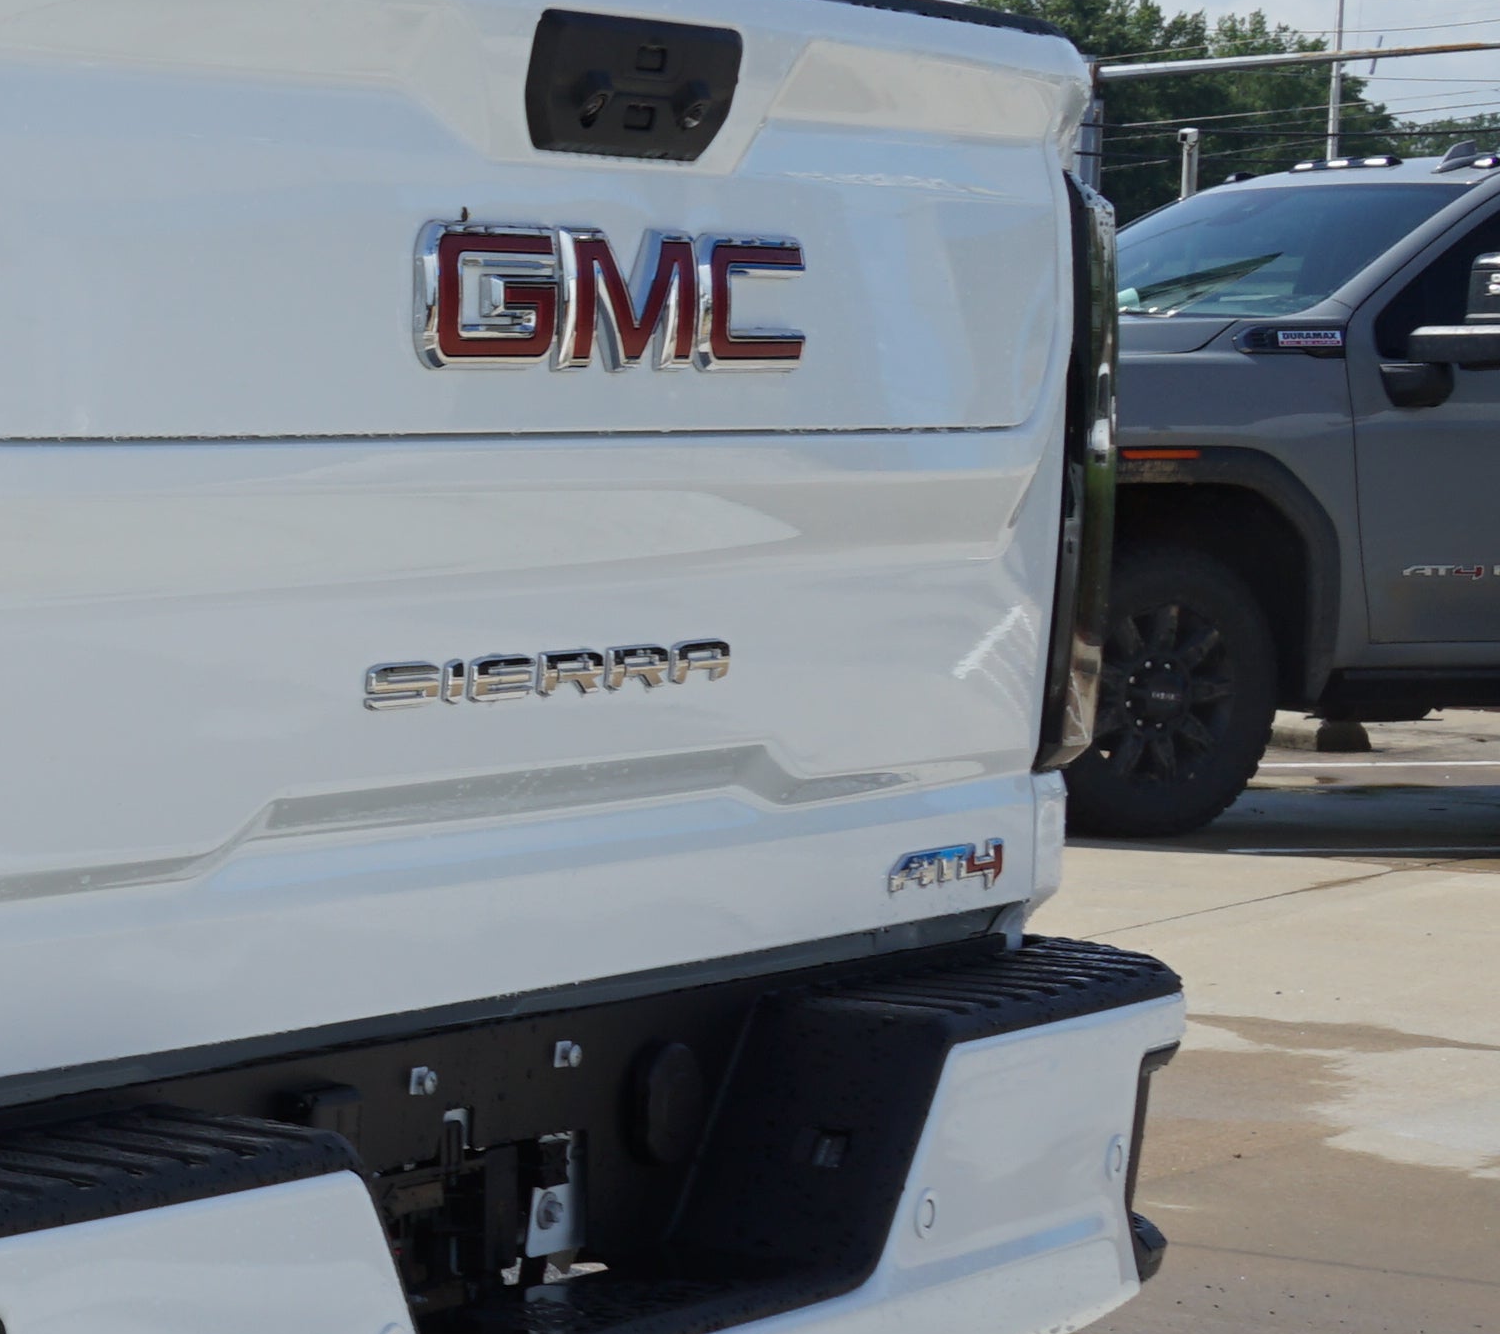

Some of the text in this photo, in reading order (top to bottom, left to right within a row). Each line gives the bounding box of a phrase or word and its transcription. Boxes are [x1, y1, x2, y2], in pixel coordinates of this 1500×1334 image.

[415, 219, 807, 373] GMC
[1403, 565, 1484, 580] AT4
[363, 638, 731, 711] SIERRA
[888, 836, 1005, 893] AT4
